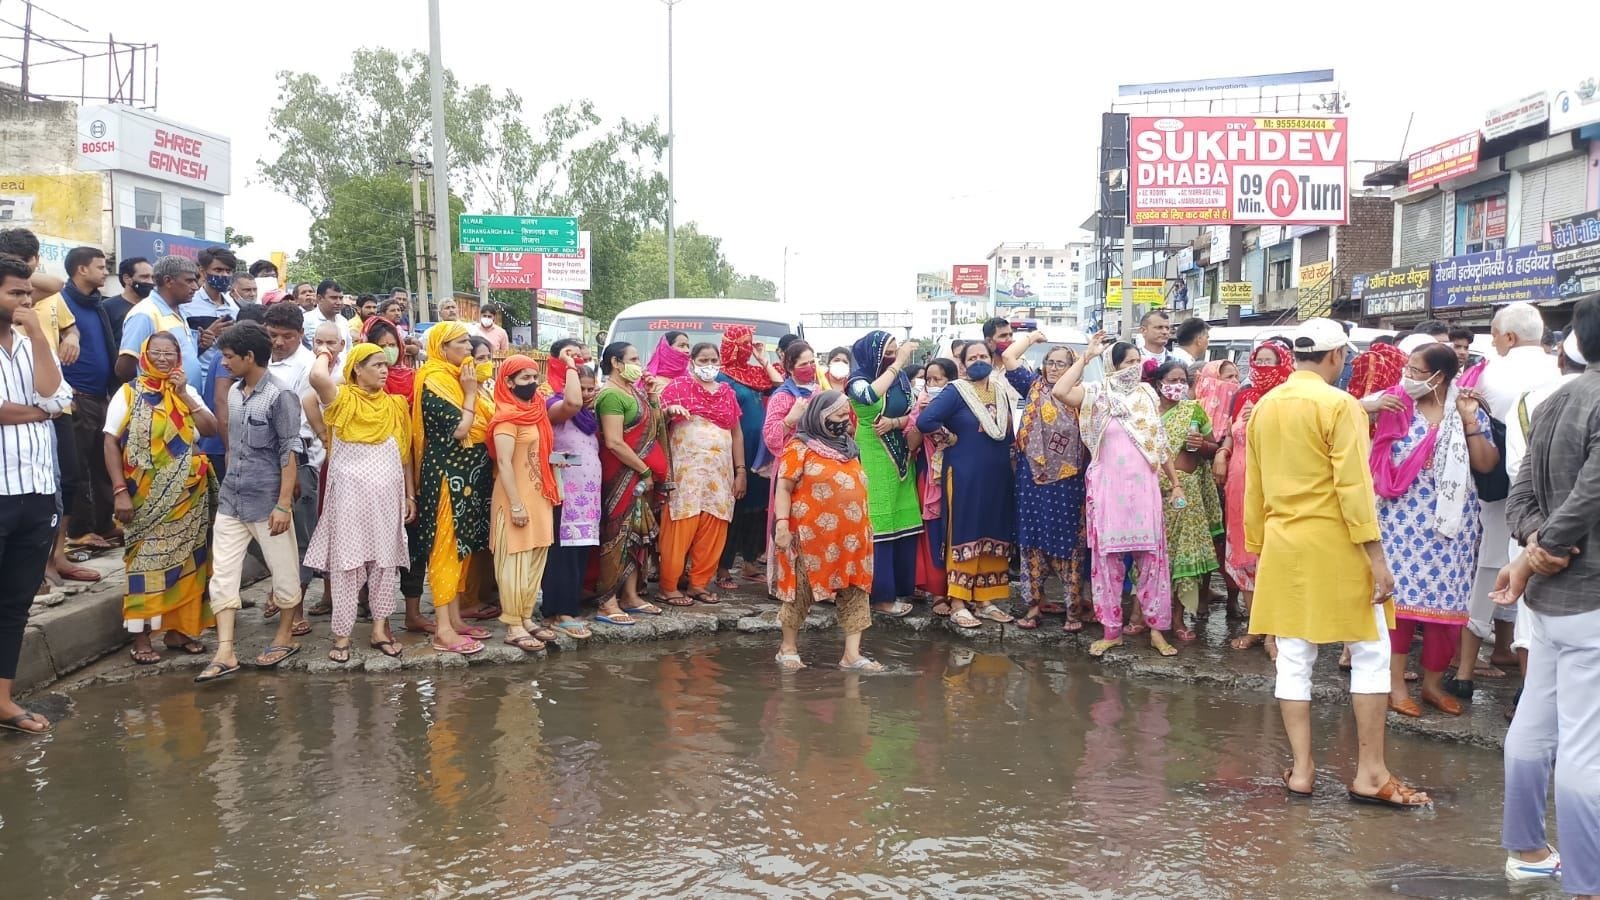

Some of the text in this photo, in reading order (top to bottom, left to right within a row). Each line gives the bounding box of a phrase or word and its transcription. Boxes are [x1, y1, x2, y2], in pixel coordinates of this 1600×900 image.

[1263, 119, 1326, 129] M: 9555434444
[82, 141, 115, 154] BOSCH
[153, 128, 202, 158] SHREE
[1136, 130, 1343, 162] SUKHDEV
[148, 150, 208, 181] GANESH
[1137, 162, 1230, 186] DHABA
[1239, 173, 1263, 196] 09
[1299, 175, 1342, 210] Turn
[1237, 198, 1265, 213] Min.
[1435, 260, 1457, 282] रोशनी
[1506, 255, 1513, 274] &
[1515, 249, 1551, 275] हार्डवेयर
[648, 319, 705, 330] हरियाणा
